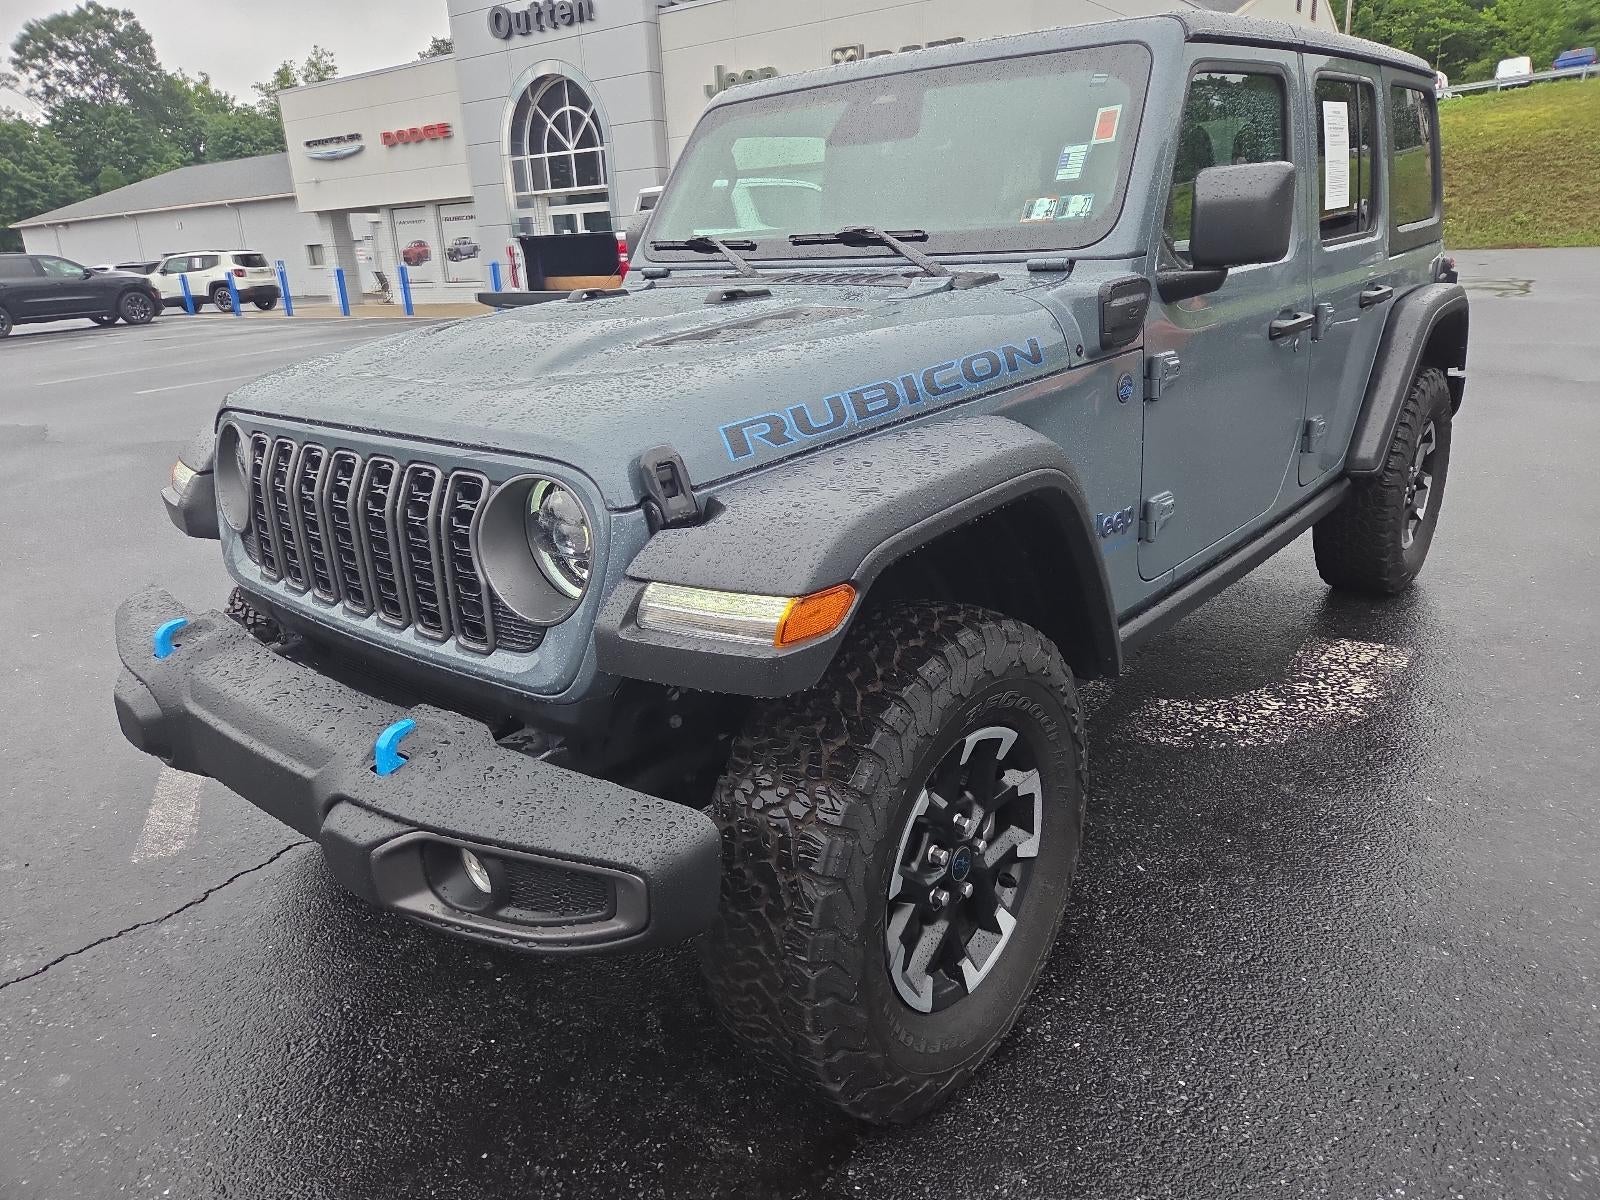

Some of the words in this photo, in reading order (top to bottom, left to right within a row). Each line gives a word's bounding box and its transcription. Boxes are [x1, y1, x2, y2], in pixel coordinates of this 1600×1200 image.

[488, 0, 594, 39] Outten
[380, 122, 454, 148] DODGE
[719, 336, 1046, 461] RUBICON
[1095, 505, 1134, 538] Jeep
